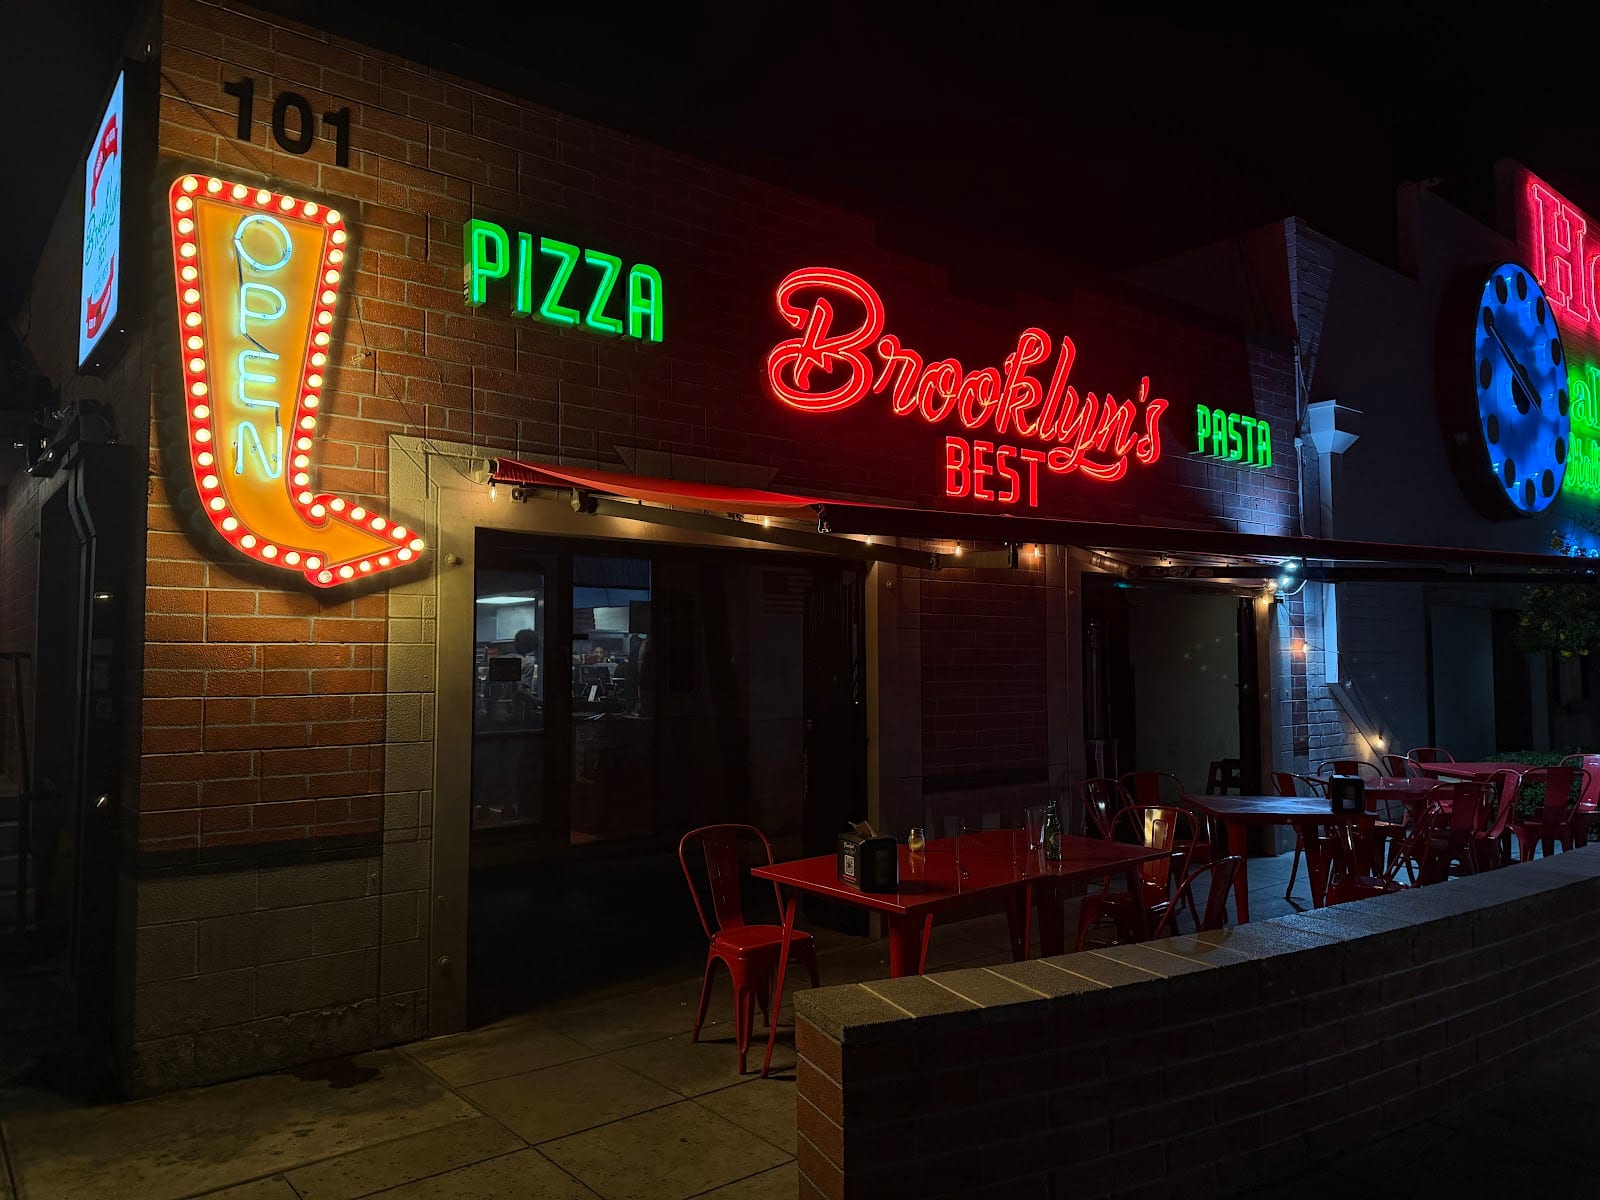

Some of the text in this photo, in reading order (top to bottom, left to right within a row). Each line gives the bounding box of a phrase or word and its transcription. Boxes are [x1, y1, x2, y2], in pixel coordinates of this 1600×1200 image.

[224, 76, 350, 168] 101
[464, 218, 664, 343] PIZZA
[234, 214, 292, 479] OPEN
[767, 267, 1169, 481] Brooklyn's
[945, 436, 1045, 507] BEST
[1197, 403, 1272, 468] PASTA
